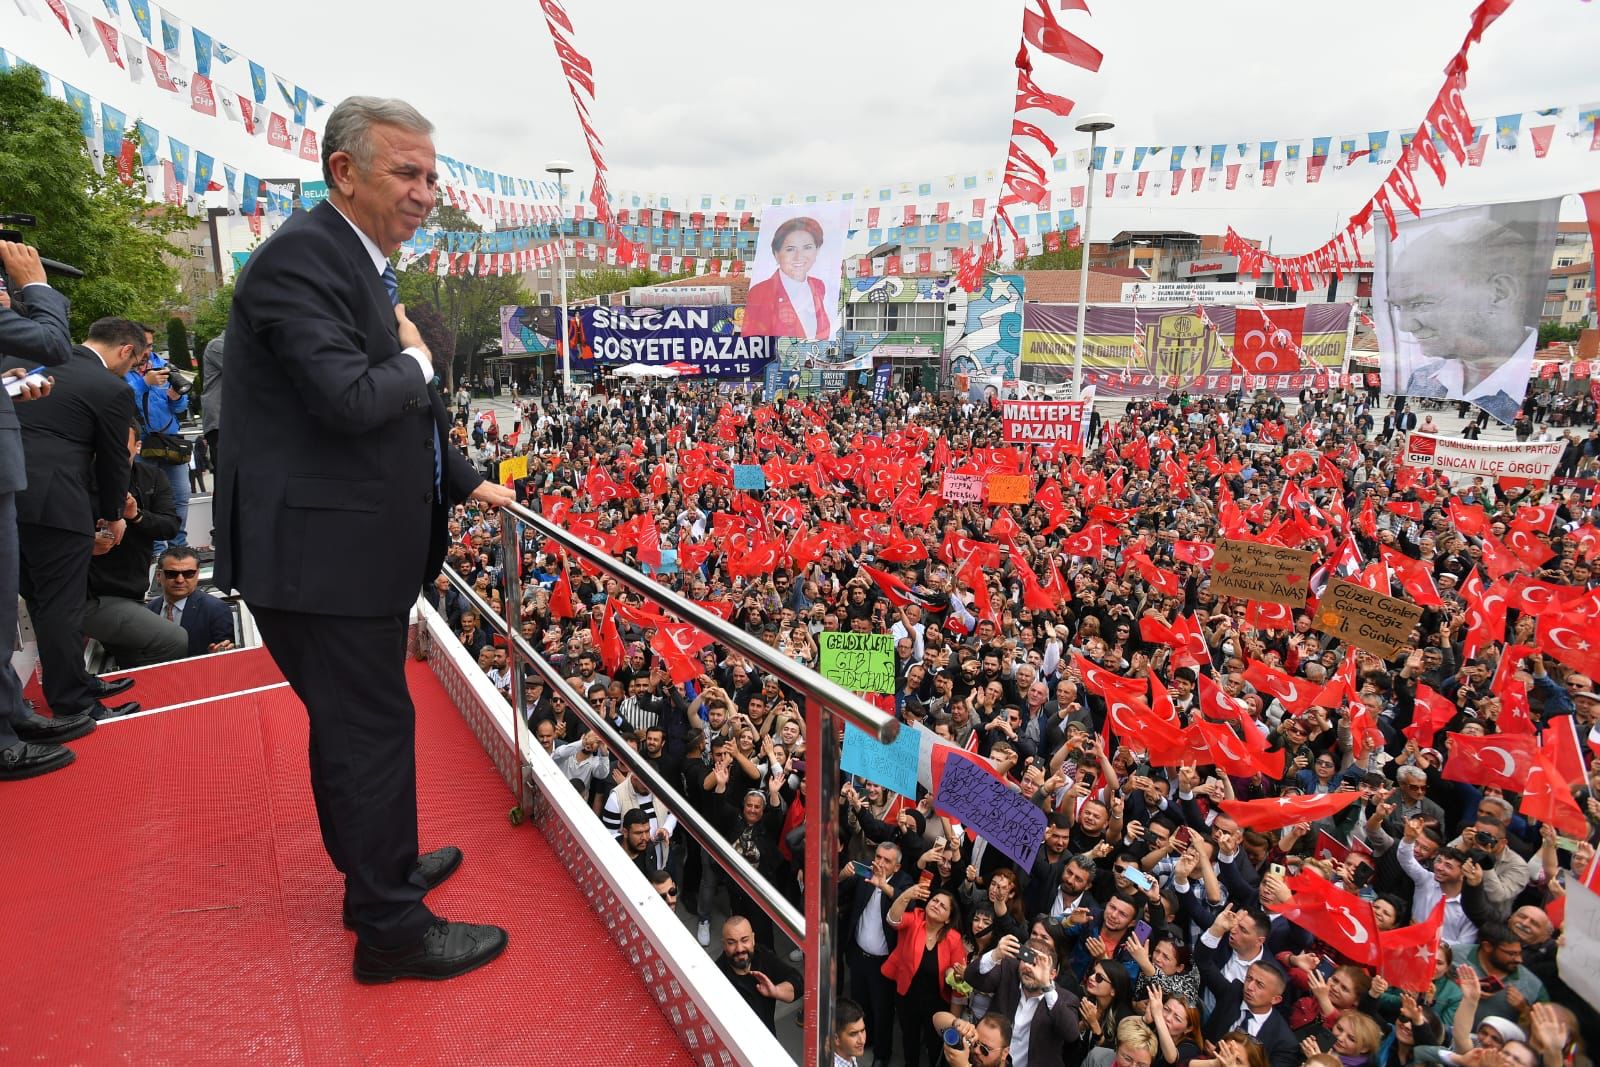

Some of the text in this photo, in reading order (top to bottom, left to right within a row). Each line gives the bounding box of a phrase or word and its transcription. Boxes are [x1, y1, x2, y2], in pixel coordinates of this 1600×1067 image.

[194, 97, 214, 106] CHP
[272, 132, 288, 141] CHP
[593, 336, 770, 360] SOSYETE PAZARI
[704, 364, 720, 373] 14
[734, 363, 750, 373] 15
[1003, 404, 1081, 422] MALTEPE
[1011, 423, 1072, 440] PAZARI
[1409, 454, 1432, 463] CHP
[1436, 456, 1551, 475] SİNCAN İLÇE ÖRGÜT
[1216, 575, 1266, 592] MANSUR
[1333, 583, 1419, 620] Güzel Günler
[1335, 599, 1403, 630] Göreceğiz
